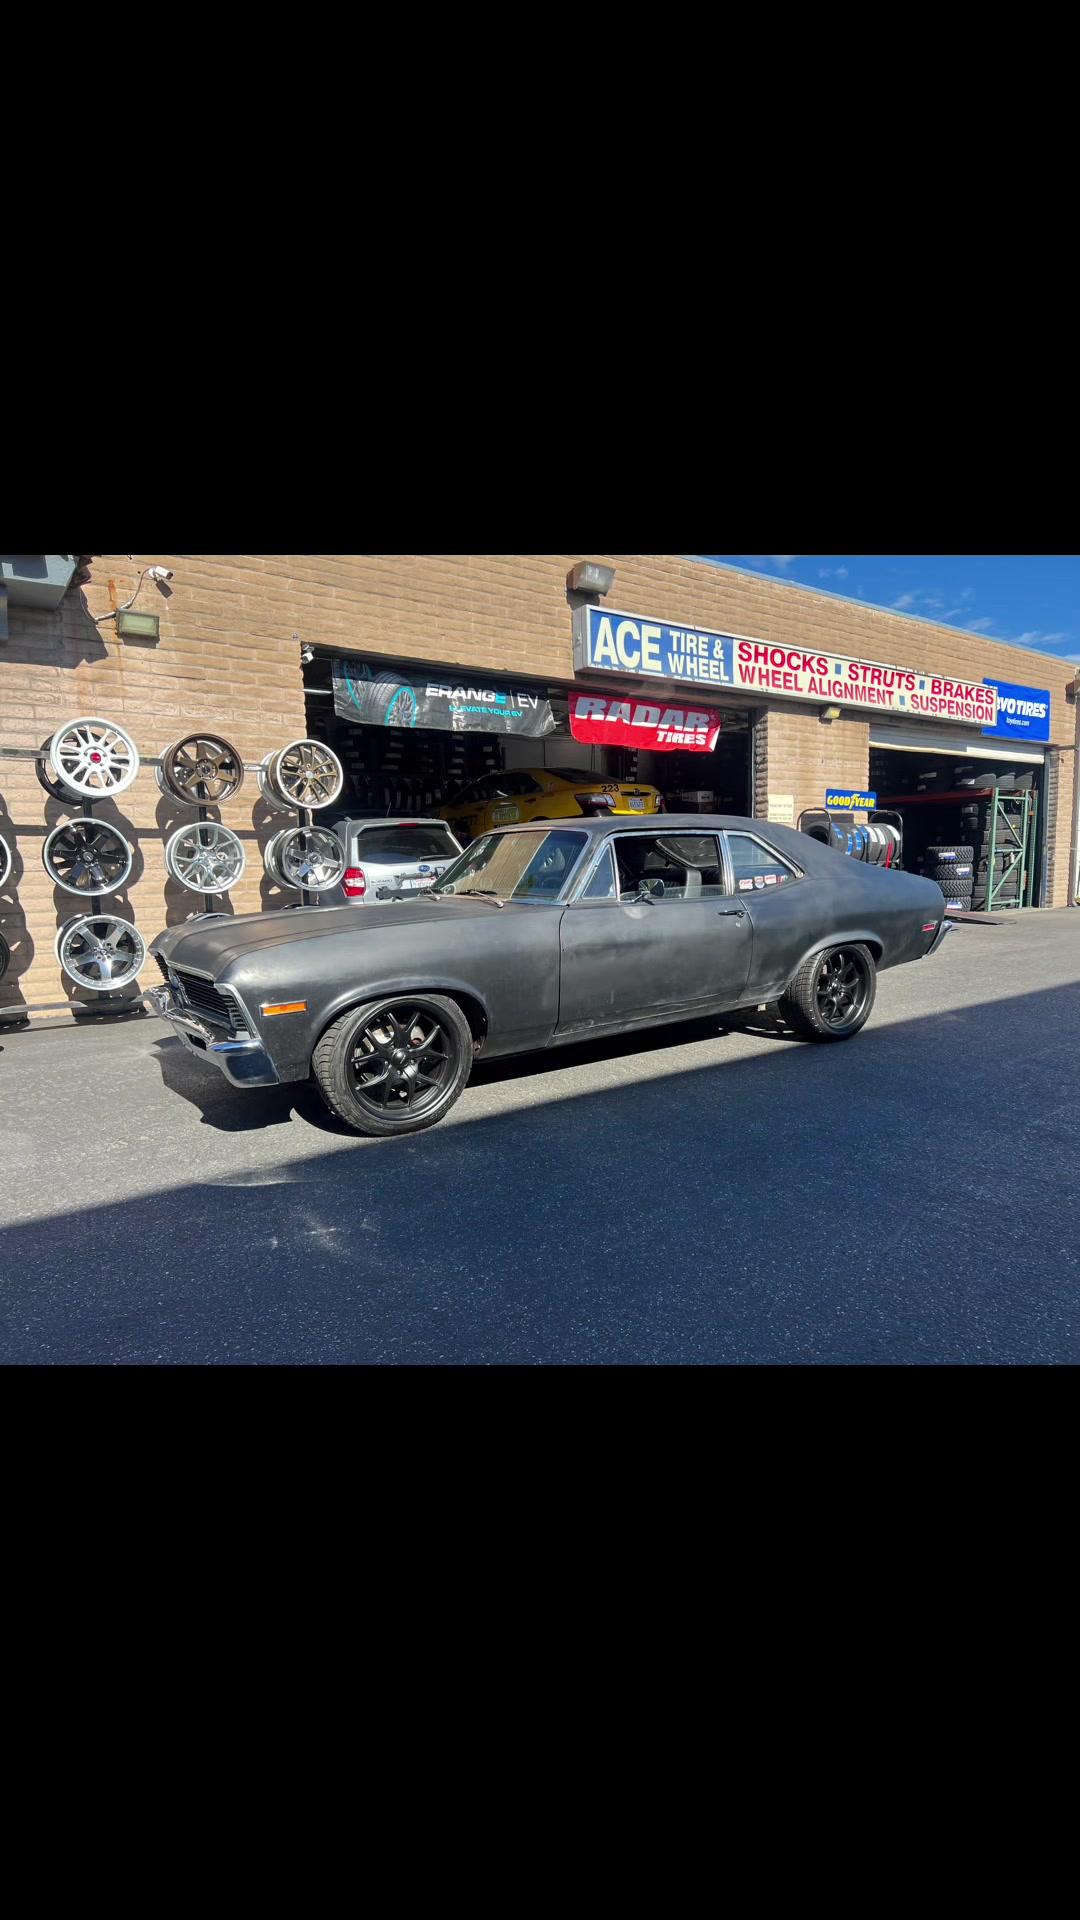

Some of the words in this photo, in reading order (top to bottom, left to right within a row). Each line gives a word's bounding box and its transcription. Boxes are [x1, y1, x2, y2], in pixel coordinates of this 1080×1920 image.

[593, 616, 662, 672] ACE
[669, 630, 709, 657] TIRE
[713, 639, 724, 659] &
[667, 652, 729, 681] WHEEL
[738, 641, 829, 676] SHOCKS
[848, 663, 916, 691] STRUTS
[931, 678, 994, 705] BRAKES
[425, 682, 507, 705] ERANGE
[517, 692, 538, 709] EV
[738, 663, 803, 692] WHEEL
[808, 676, 894, 706] ALIGNMENT
[911, 694, 993, 721] SUSPENSION
[449, 704, 488, 714] ELEVATE
[489, 707, 511, 716] YOUR
[574, 696, 710, 733] RADAR
[1016, 699, 1046, 719] TIRES
[656, 730, 707, 746] TIRES
[601, 784, 620, 793] 223
[827, 794, 875, 809] GOODYEAR
